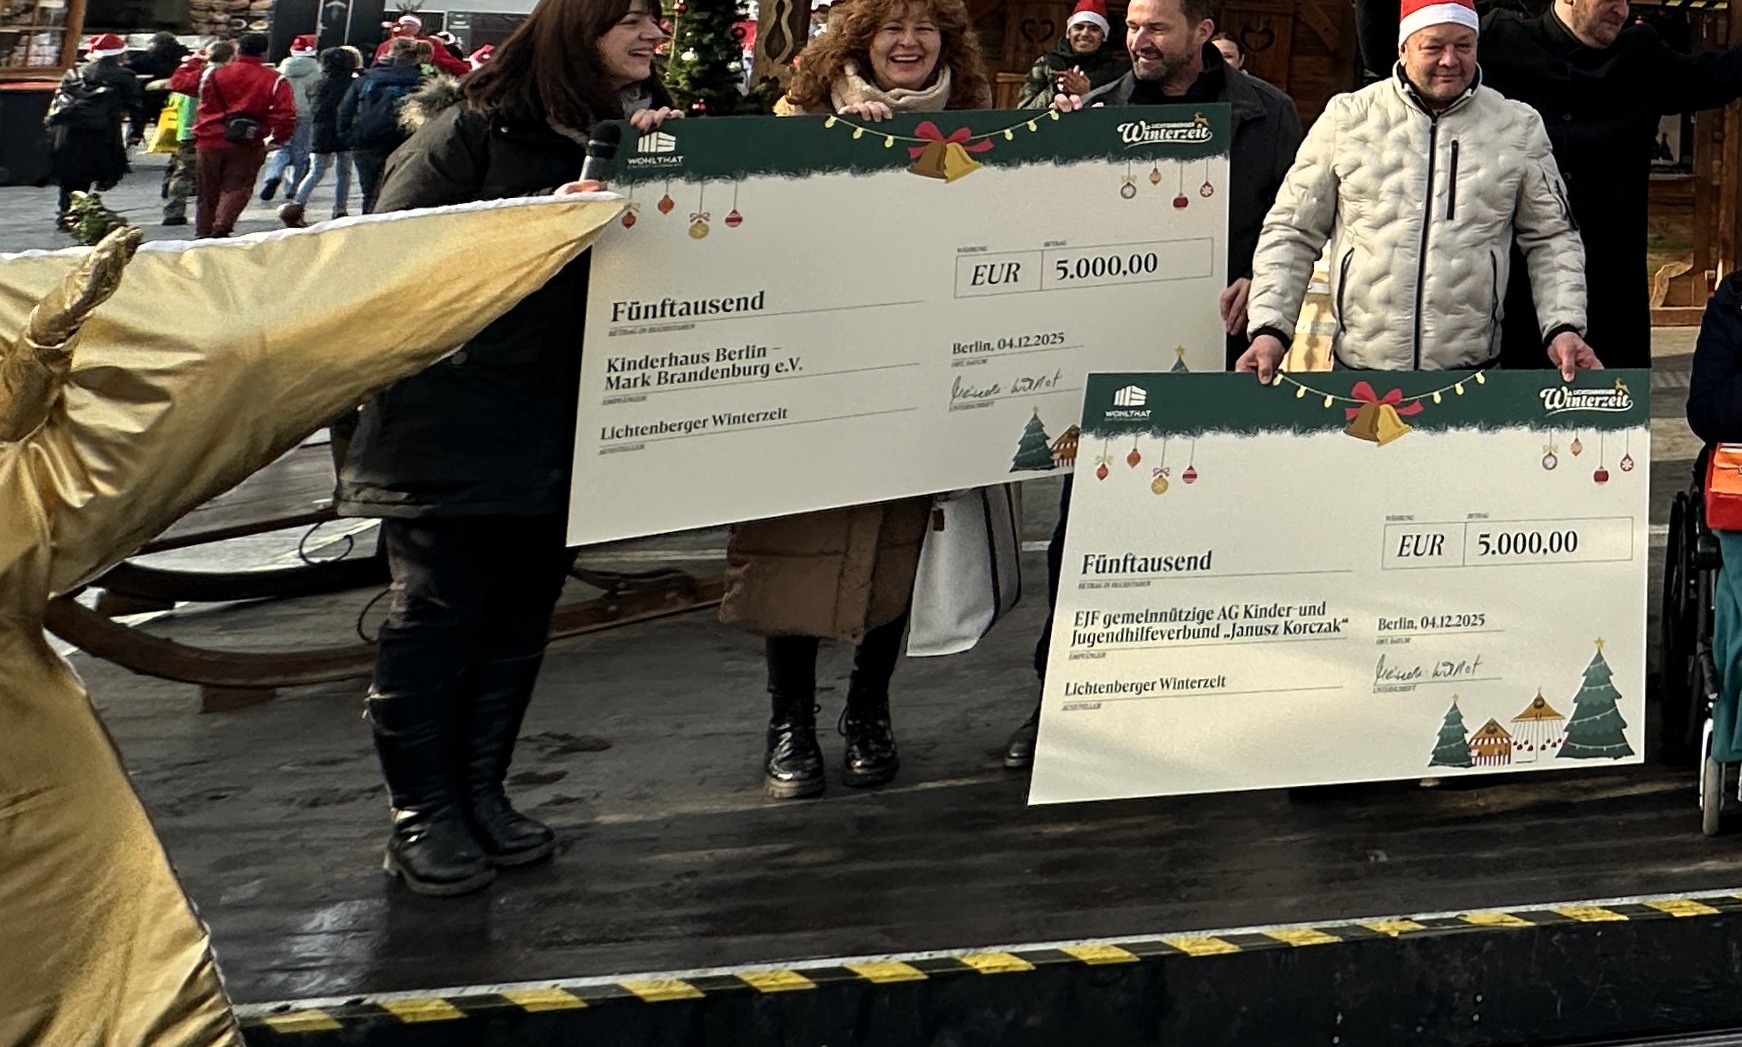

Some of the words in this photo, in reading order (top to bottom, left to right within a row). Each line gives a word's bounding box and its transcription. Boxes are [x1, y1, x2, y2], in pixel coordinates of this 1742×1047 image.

[1117, 120, 1212, 144] Winterzeit
[628, 156, 684, 164] WOHLTHAT
[970, 262, 1021, 286] EUR
[1056, 253, 1158, 281] 5.000,00
[611, 291, 765, 322] Fünftausend
[953, 340, 994, 354] Berlin,
[998, 332, 1065, 349] 04.12.2025
[607, 351, 710, 373] Kinderhaus
[715, 345, 767, 363] Berlin
[605, 373, 651, 390] Mark
[656, 362, 770, 386] Brandenburg
[775, 357, 802, 373] e.V.
[1540, 386, 1633, 410] Winterzeit
[601, 417, 709, 440] Lichtenberger
[712, 408, 788, 426] Winterzeit
[1397, 534, 1445, 557] EUR
[1478, 531, 1578, 556] 5.000,00
[1081, 550, 1212, 574] Fünftausend
[1074, 610, 1100, 628] EJF
[1102, 606, 1214, 626] gemeinnützige
[1217, 604, 1239, 620] AG
[1300, 601, 1326, 616] und
[1378, 618, 1418, 631] Berlin,
[1421, 614, 1485, 629] 04.12.2025
[1071, 624, 1220, 648] Jugendhilfeverbund
[1224, 622, 1279, 640] „Janusz
[1283, 618, 1348, 635] Korczak“
[1064, 680, 1157, 696] Lichtenberger
[1160, 675, 1226, 690] Winterzeit
